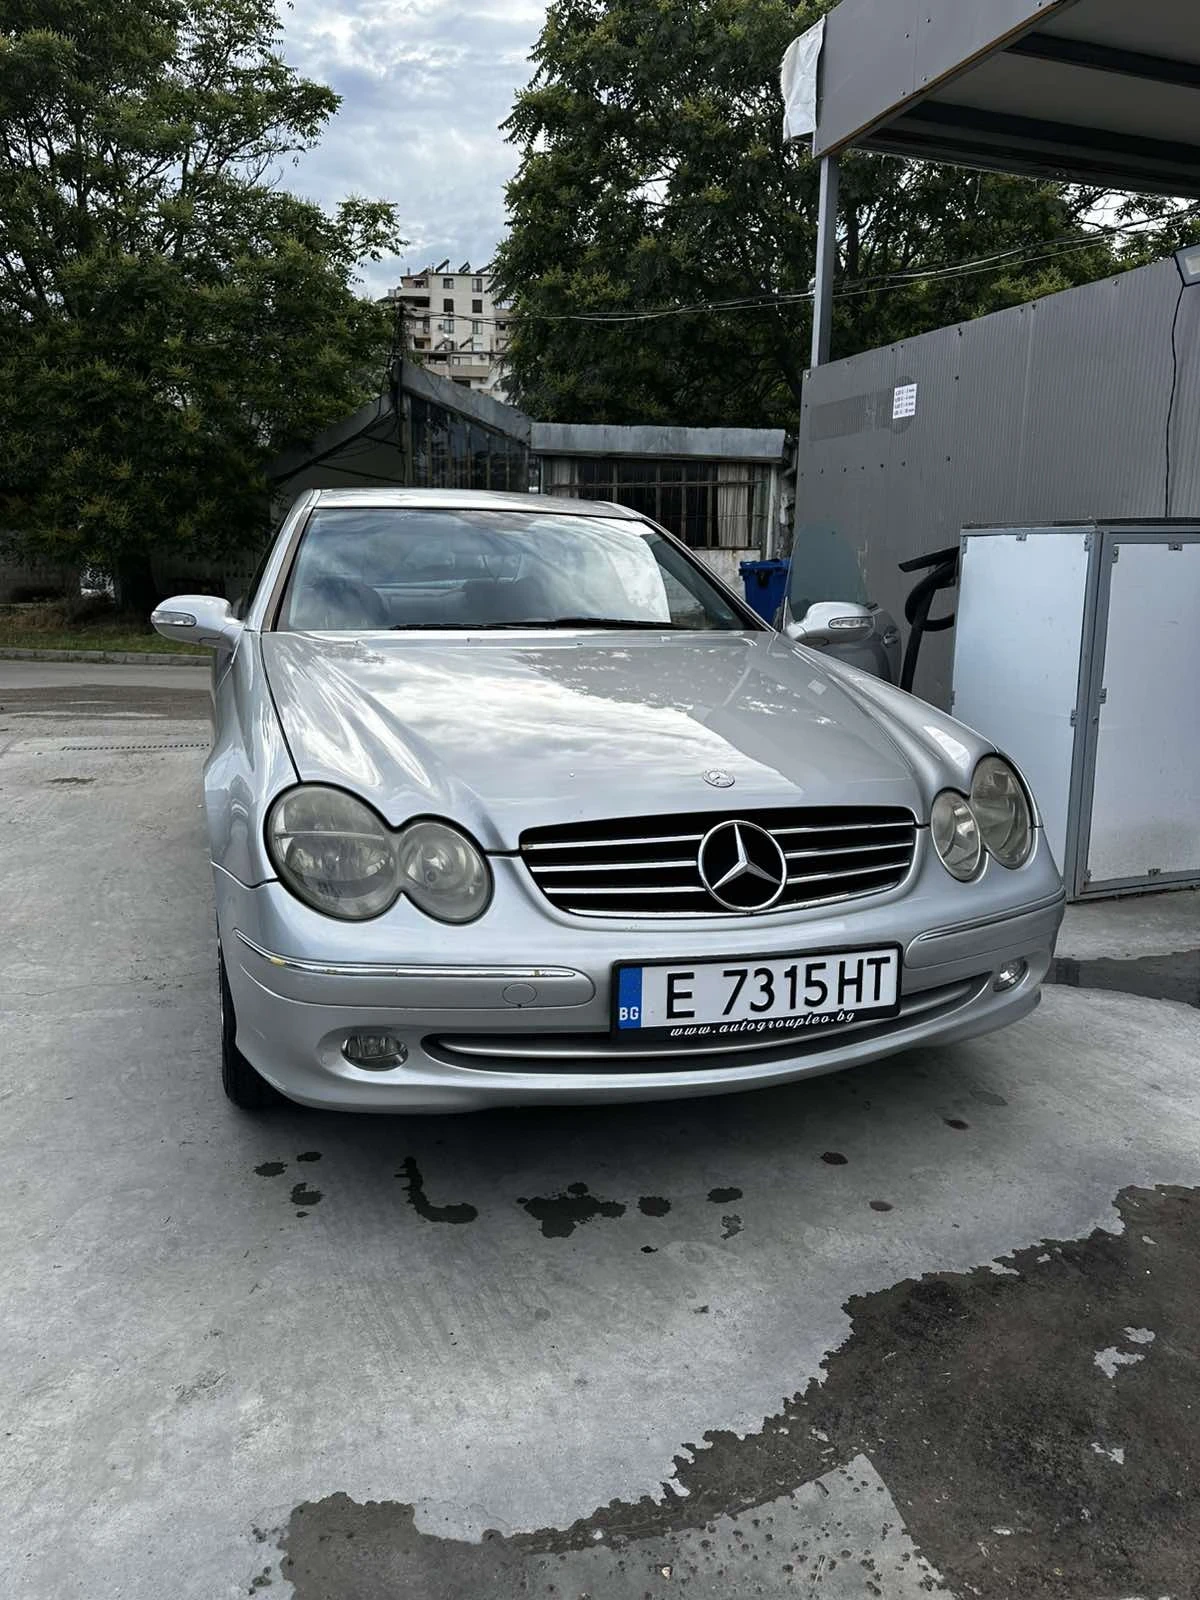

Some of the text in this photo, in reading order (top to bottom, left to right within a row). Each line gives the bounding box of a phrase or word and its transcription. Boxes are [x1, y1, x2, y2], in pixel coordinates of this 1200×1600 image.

[665, 971, 695, 1019] E
[618, 1006, 640, 1021] BG
[669, 1012, 855, 1037] www.autogroupleo.bg
